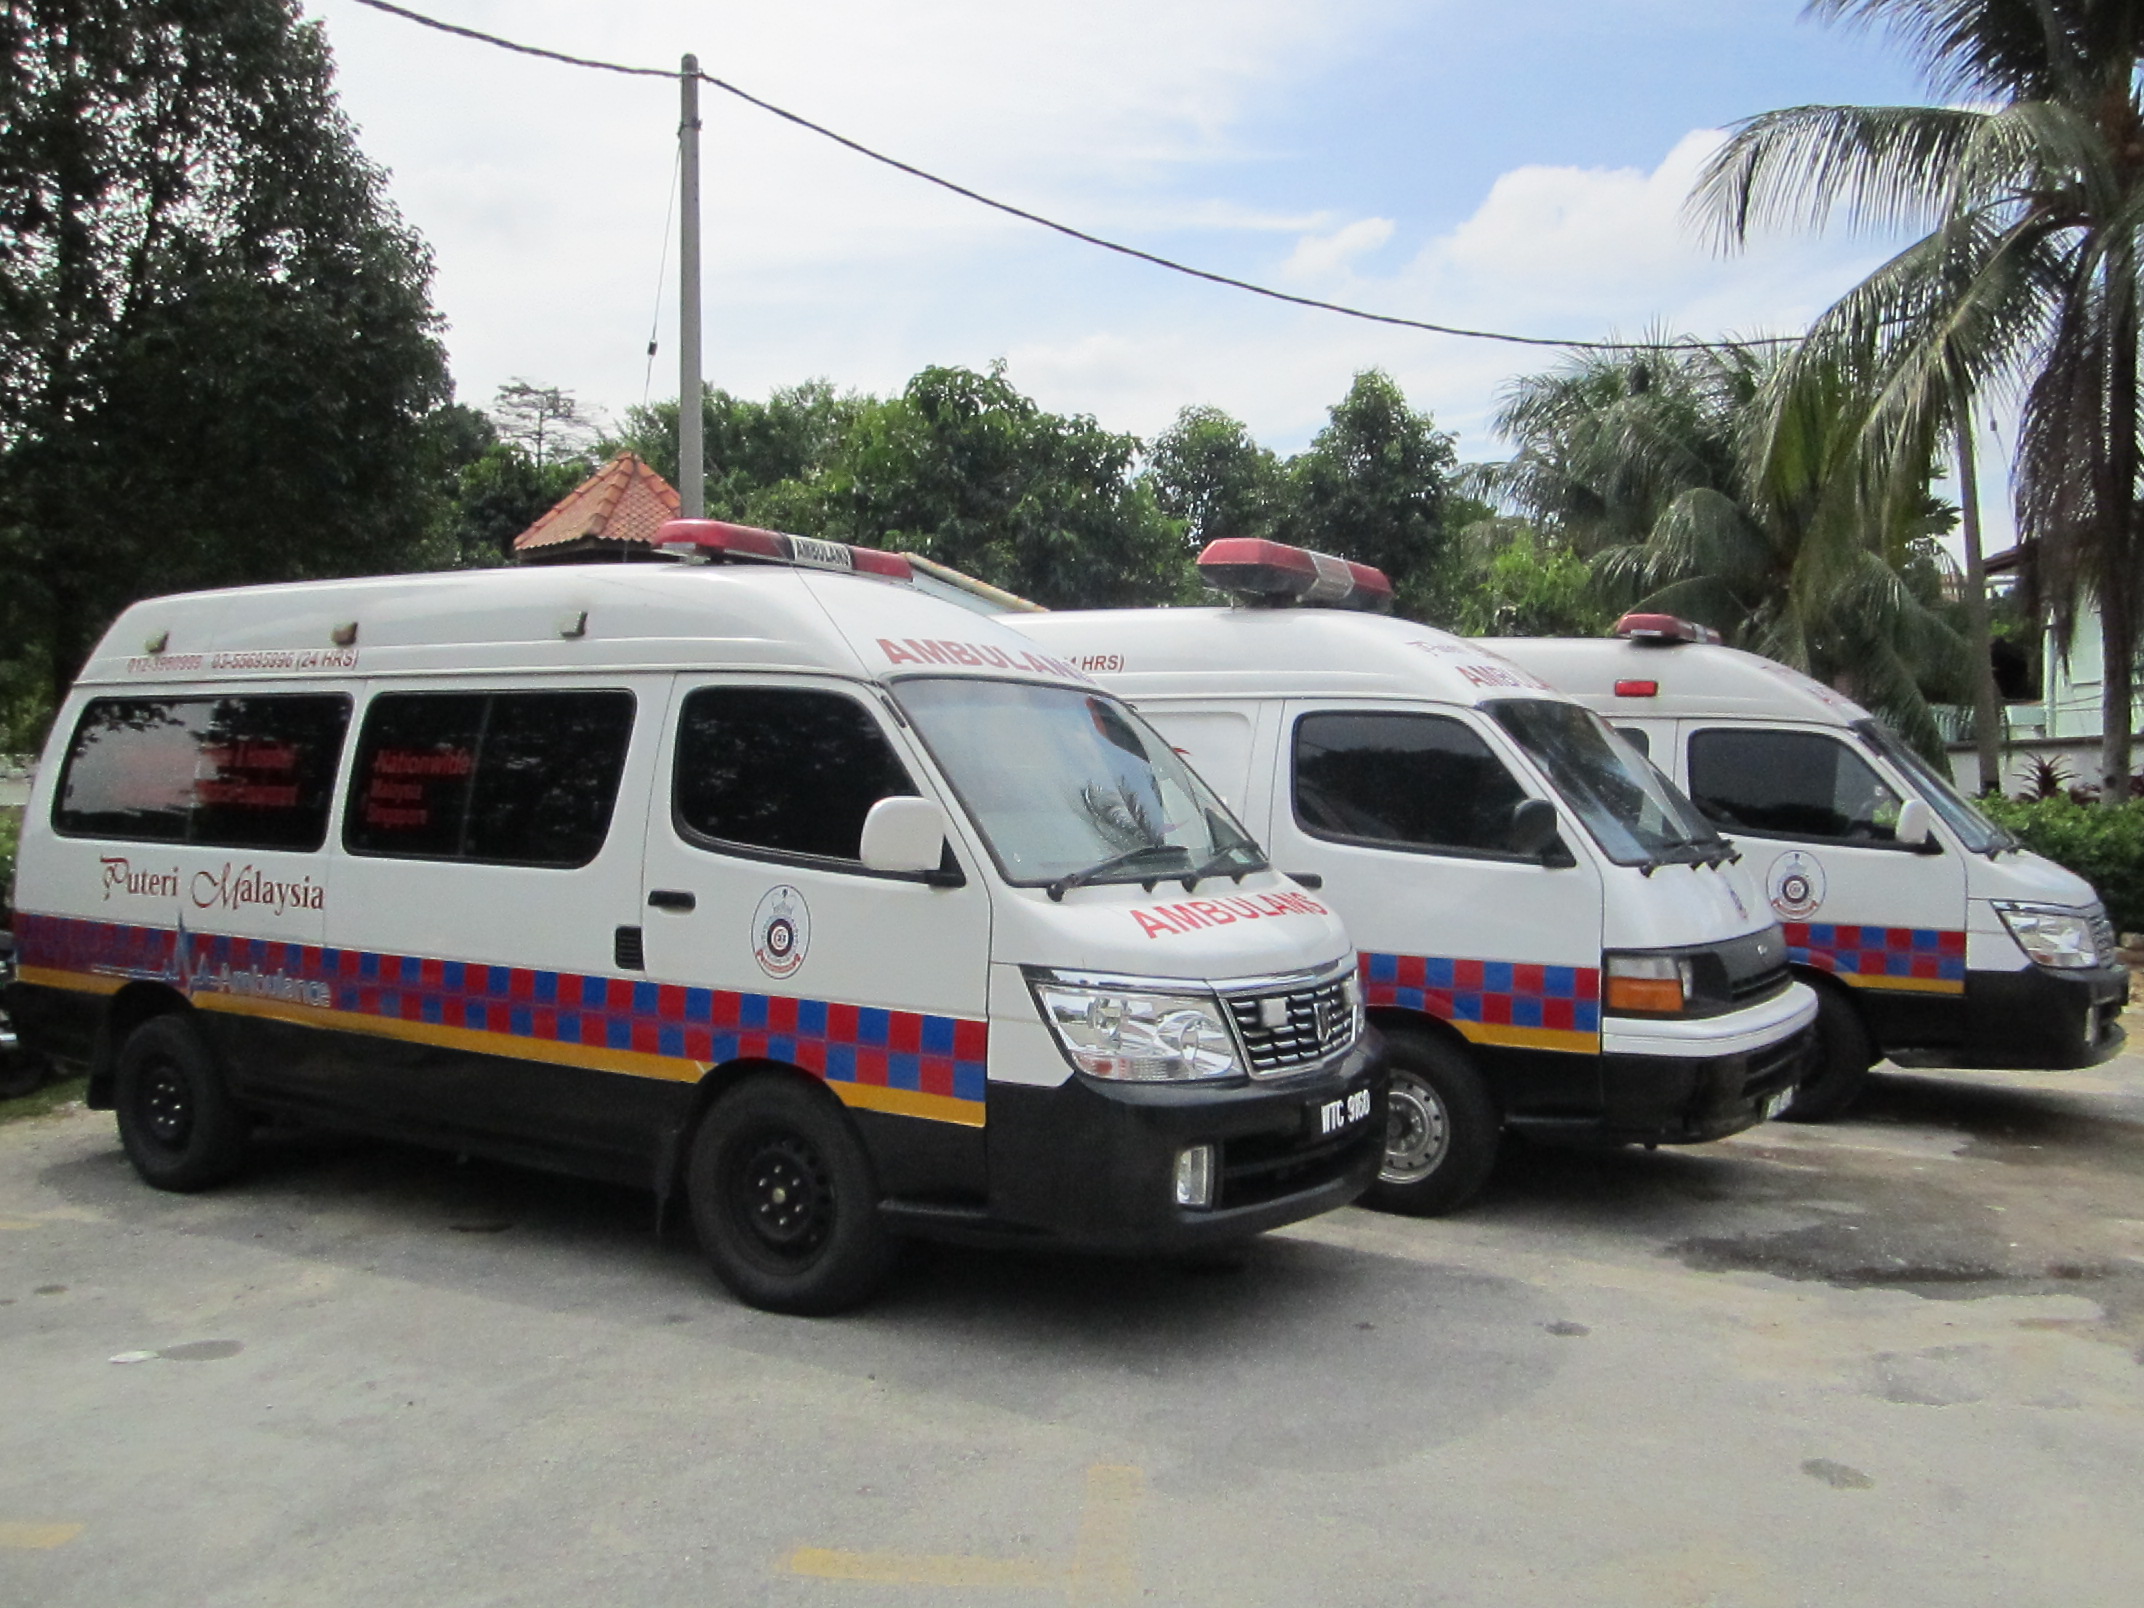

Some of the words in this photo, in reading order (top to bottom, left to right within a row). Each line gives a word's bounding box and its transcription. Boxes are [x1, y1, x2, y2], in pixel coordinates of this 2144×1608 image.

[321, 648, 360, 671] HRS)
[1081, 654, 1125, 673] HRS)
[100, 856, 180, 901] Puteri
[190, 862, 325, 917] Malaysia
[1129, 891, 1329, 939] AMBULANS
